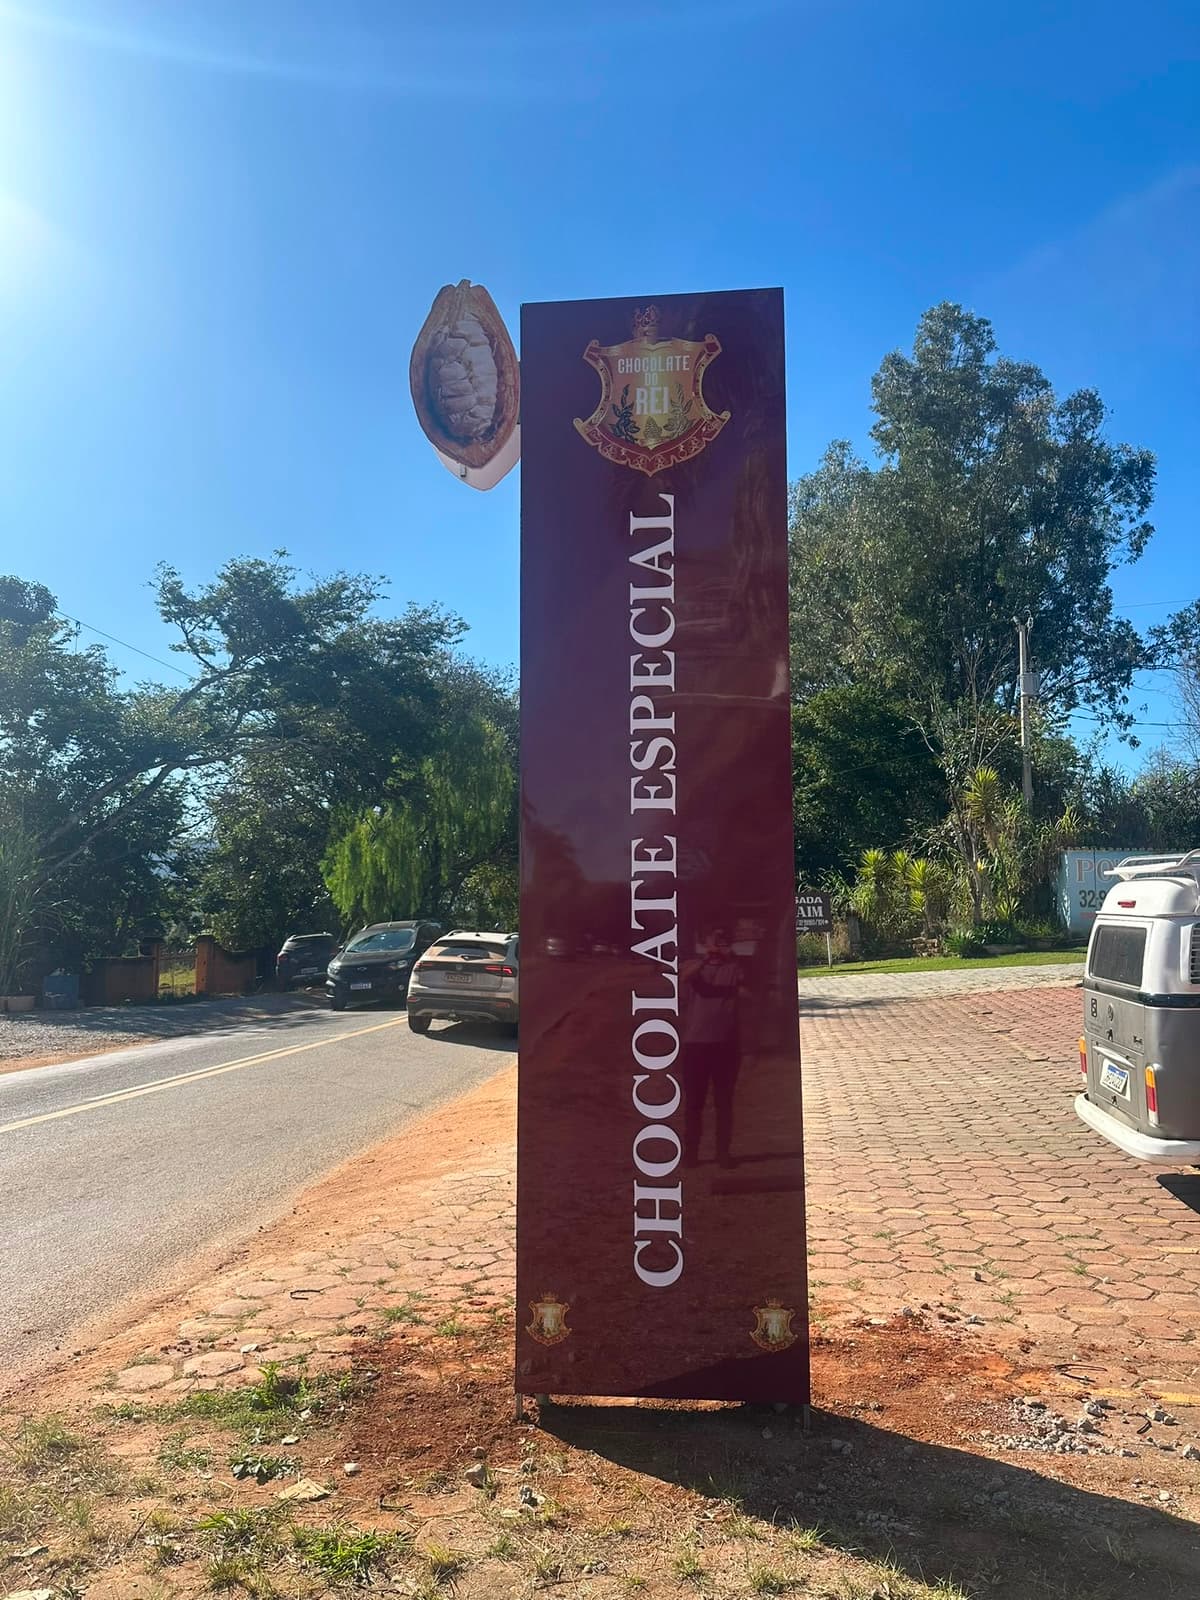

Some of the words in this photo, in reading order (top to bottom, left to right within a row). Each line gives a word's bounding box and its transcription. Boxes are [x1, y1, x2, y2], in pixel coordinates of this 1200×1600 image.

[617, 356, 690, 373] CHOCOLATE
[645, 373, 658, 385] DO
[636, 387, 669, 414] REI
[628, 492, 677, 816] ESPECIAL
[630, 834, 684, 1287] CHOCOLATE
